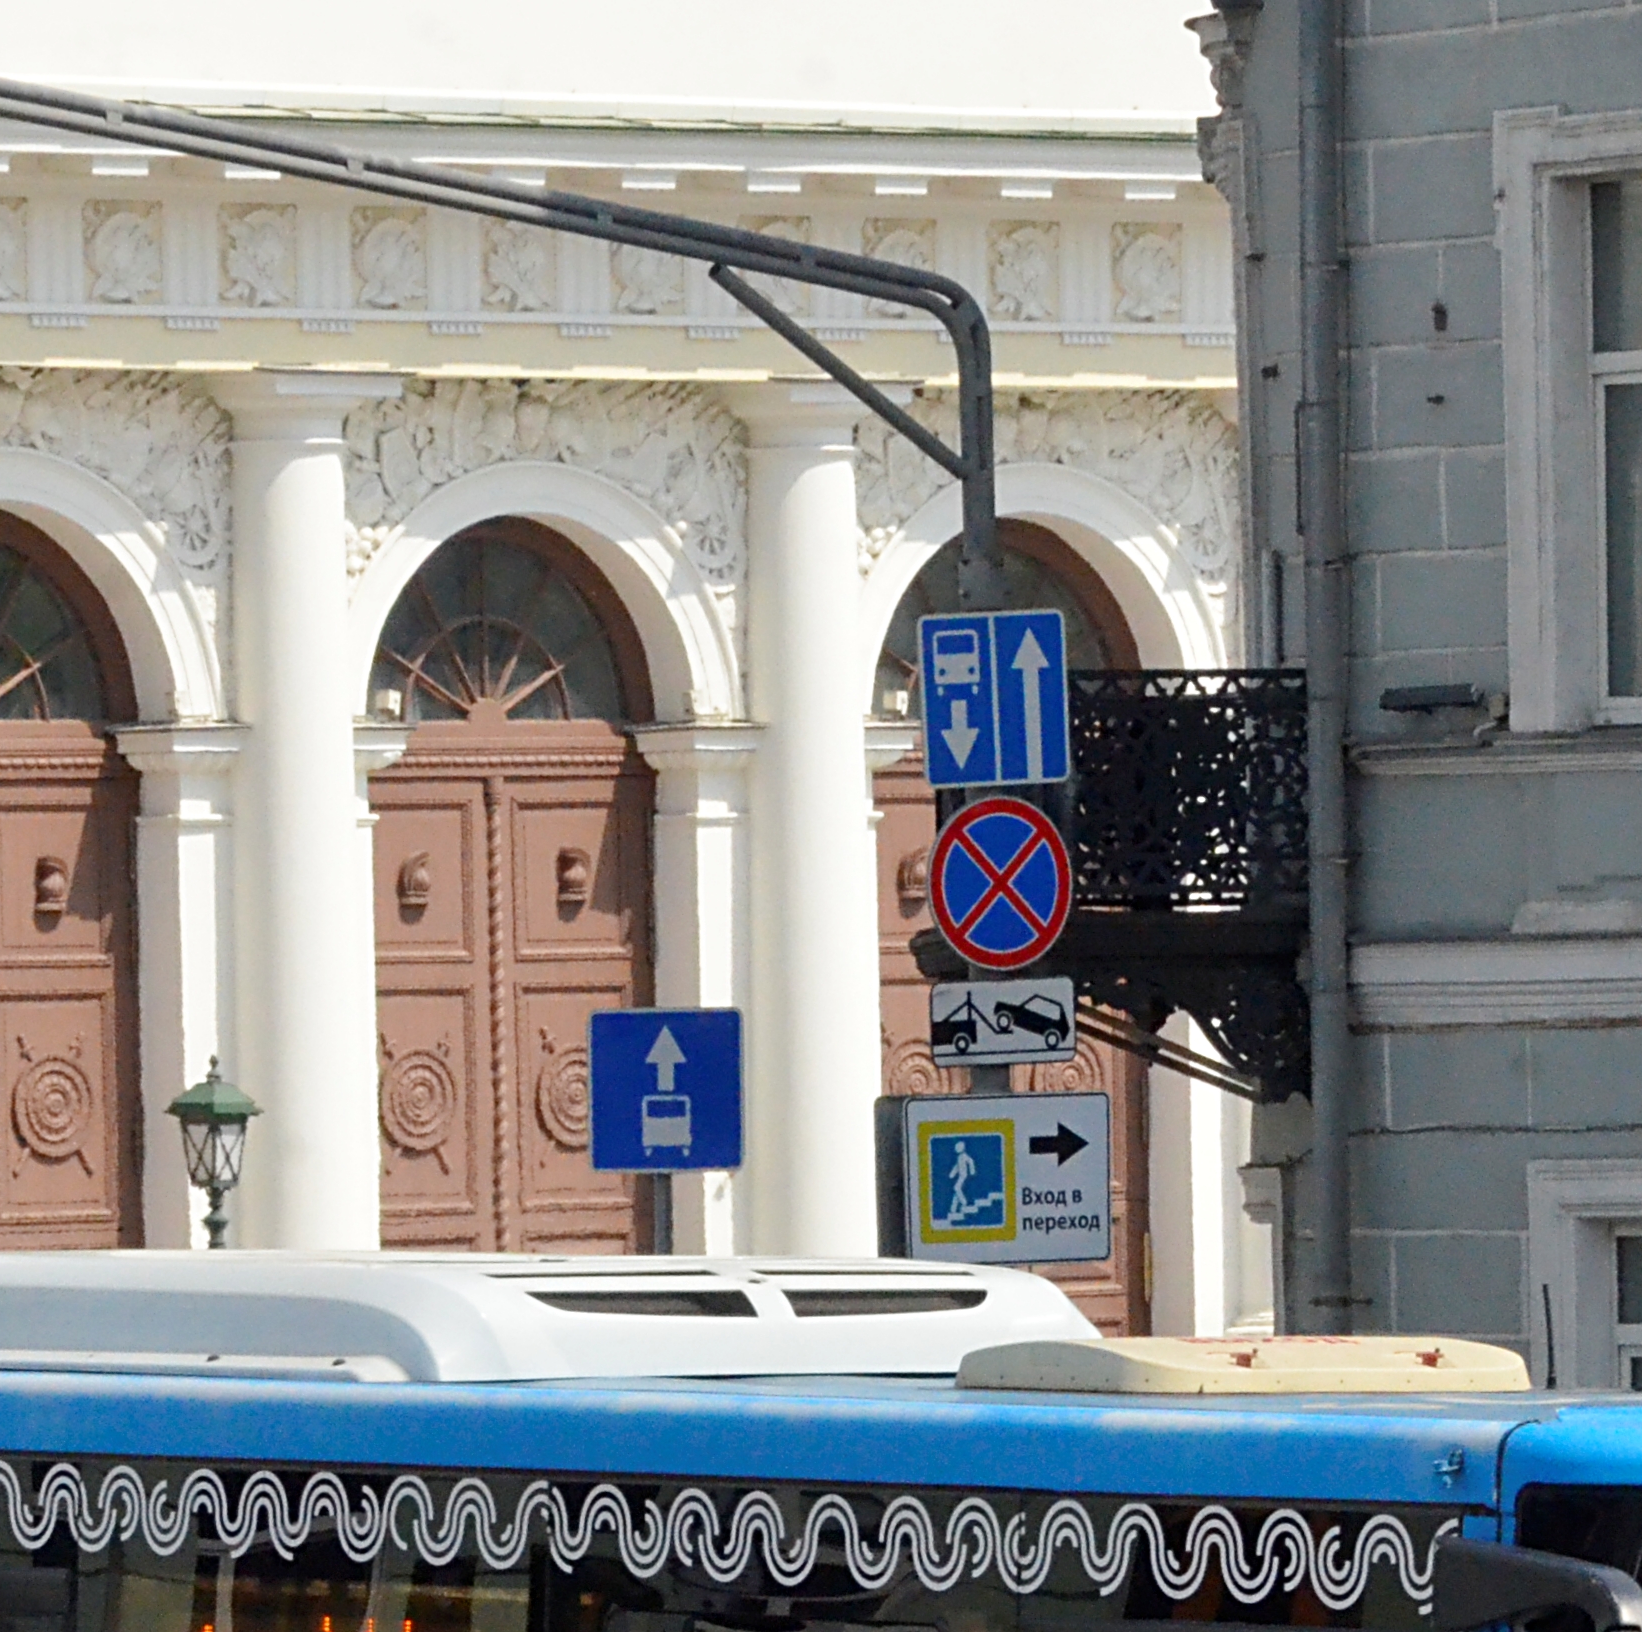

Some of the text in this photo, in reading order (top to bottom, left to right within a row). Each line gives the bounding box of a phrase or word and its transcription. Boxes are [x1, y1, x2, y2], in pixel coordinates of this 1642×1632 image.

[1021, 1186, 1083, 1208] Вход в
[1021, 1214, 1101, 1236] переход
